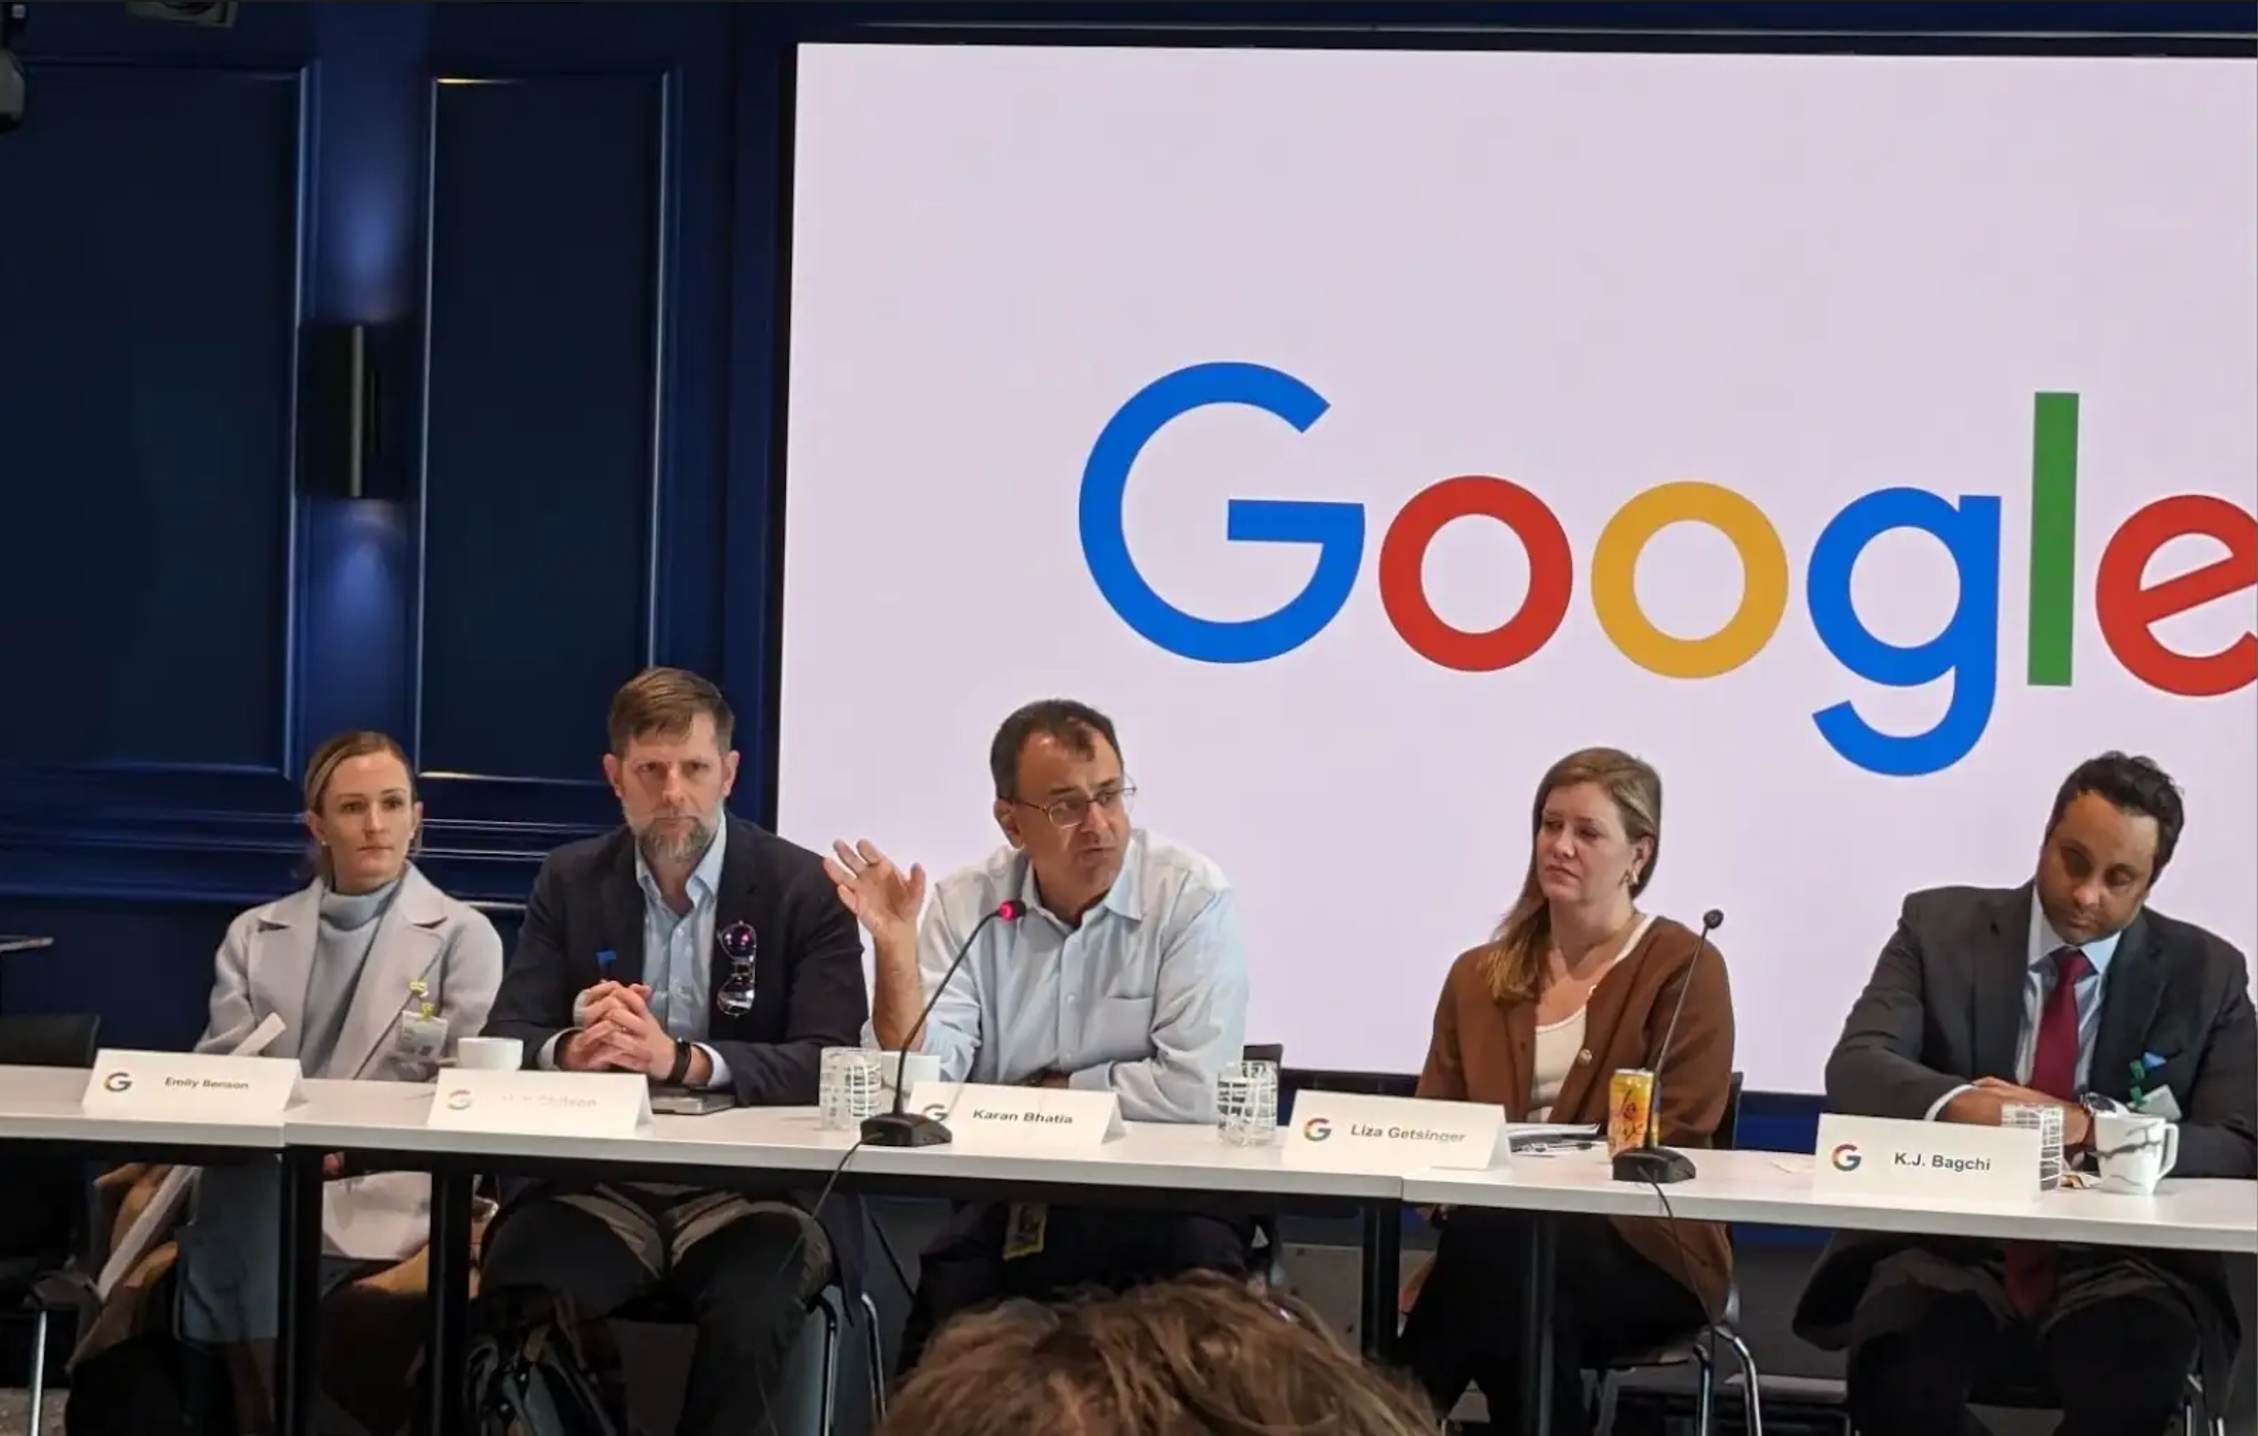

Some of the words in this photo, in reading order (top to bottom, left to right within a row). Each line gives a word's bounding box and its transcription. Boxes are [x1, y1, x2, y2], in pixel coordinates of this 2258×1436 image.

[1079, 361, 2258, 776] Google
[165, 1077, 199, 1088] Emily
[202, 1079, 249, 1089] Benson
[973, 1109, 1018, 1122] Karan
[1023, 1112, 1073, 1124] Bhatia
[1303, 1117, 1332, 1142] G
[1350, 1124, 1383, 1138] Liza
[1388, 1126, 1466, 1144] Getsinger
[1832, 1143, 1862, 1172] G
[1894, 1152, 1926, 1167] K.J.
[1932, 1154, 1991, 1172] Bagchi
